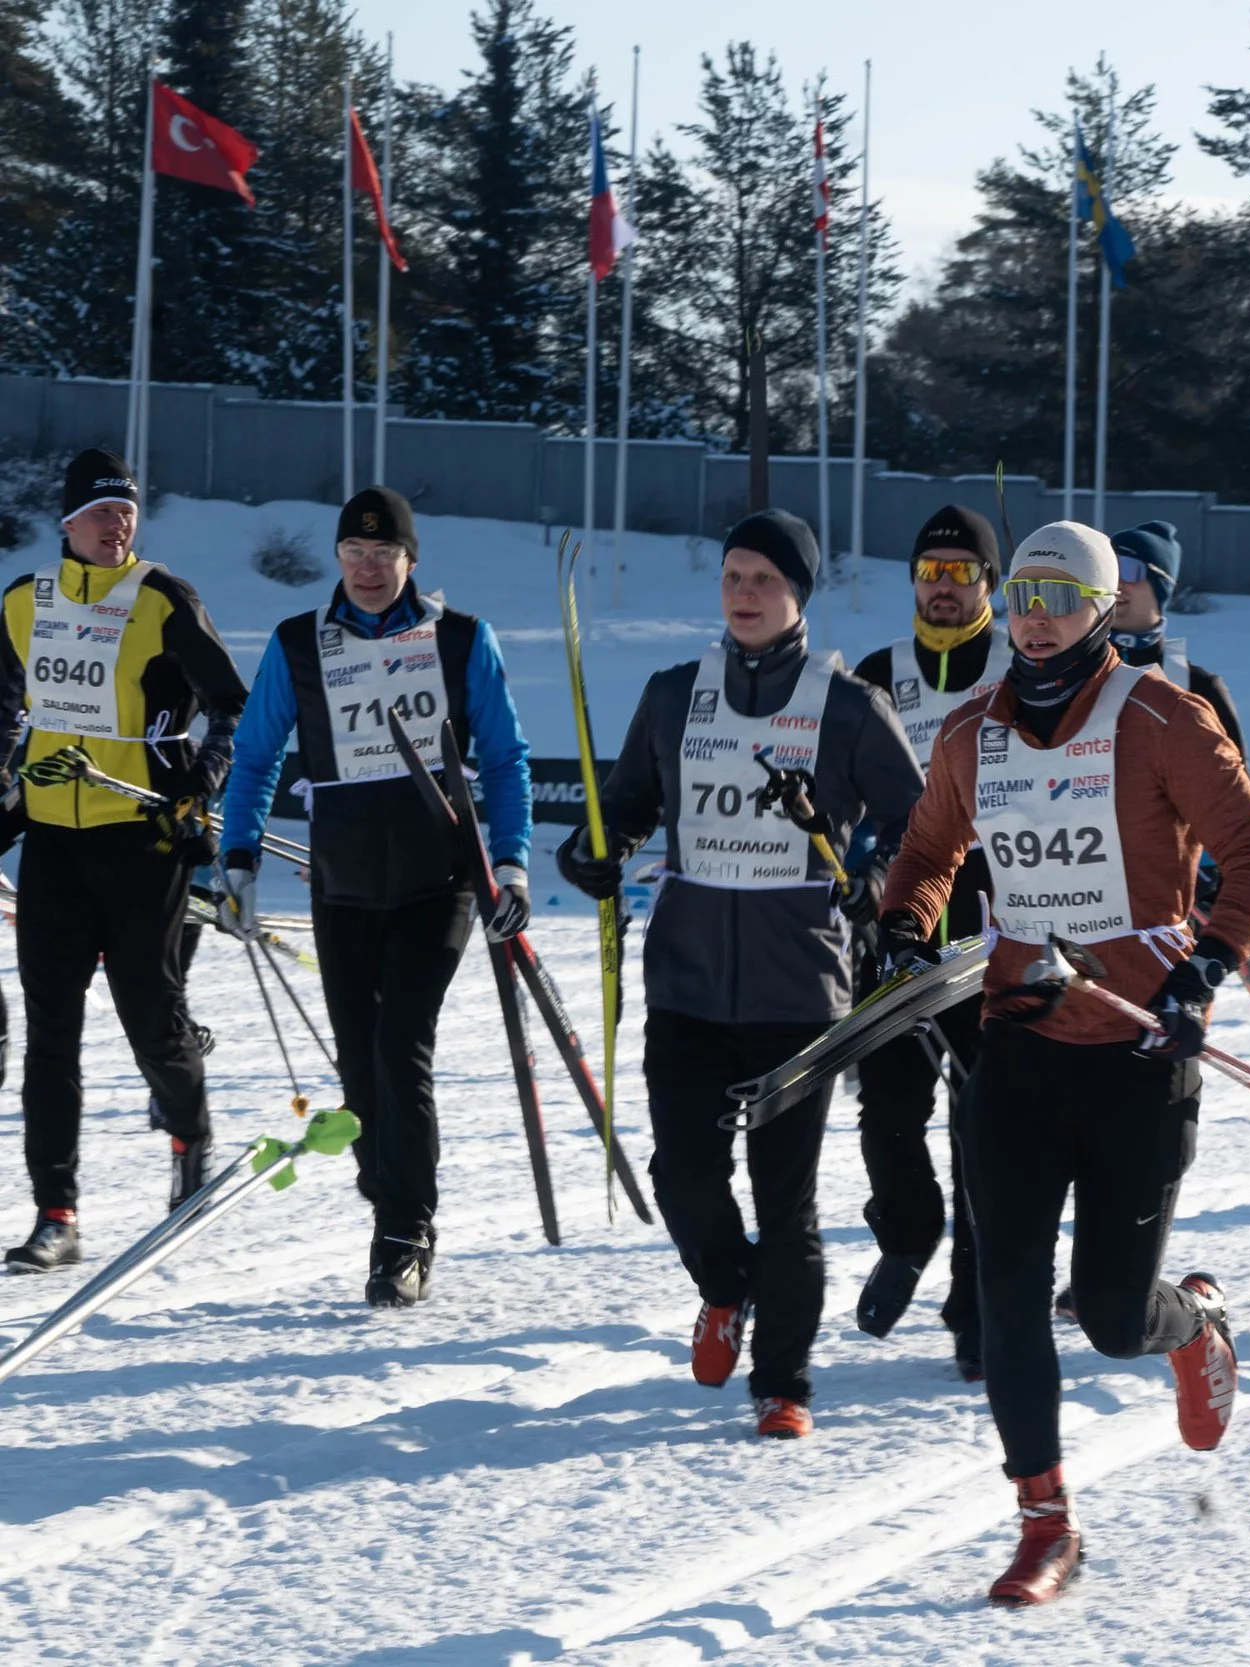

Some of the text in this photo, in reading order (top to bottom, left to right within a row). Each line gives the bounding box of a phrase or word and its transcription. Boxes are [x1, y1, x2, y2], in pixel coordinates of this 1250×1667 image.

[90, 604, 129, 617] renta
[391, 630, 434, 644] renta
[35, 656, 105, 687] 6940
[324, 661, 372, 679] VITAMIN
[325, 676, 356, 689] WELL
[42, 698, 101, 714] SALOMON
[340, 690, 436, 732] 7140
[770, 714, 819, 731] renta
[353, 735, 435, 757] SALOON
[685, 736, 739, 751] VITAMIN
[776, 744, 813, 757] INTER
[1065, 738, 1112, 758] renta
[683, 747, 715, 761] WELL
[980, 753, 1008, 766] 2023
[344, 762, 398, 780] LAHTI
[978, 778, 1034, 796] VITAMIN
[1072, 774, 1111, 786] INTER
[1071, 786, 1110, 800] SPORT
[978, 794, 1009, 810] WELL
[694, 836, 790, 854] SALOMON
[991, 826, 1108, 869] 6942
[752, 865, 800, 879] Hollola
[1007, 889, 1104, 908] SALOMON
[1068, 916, 1124, 935] Hollola
